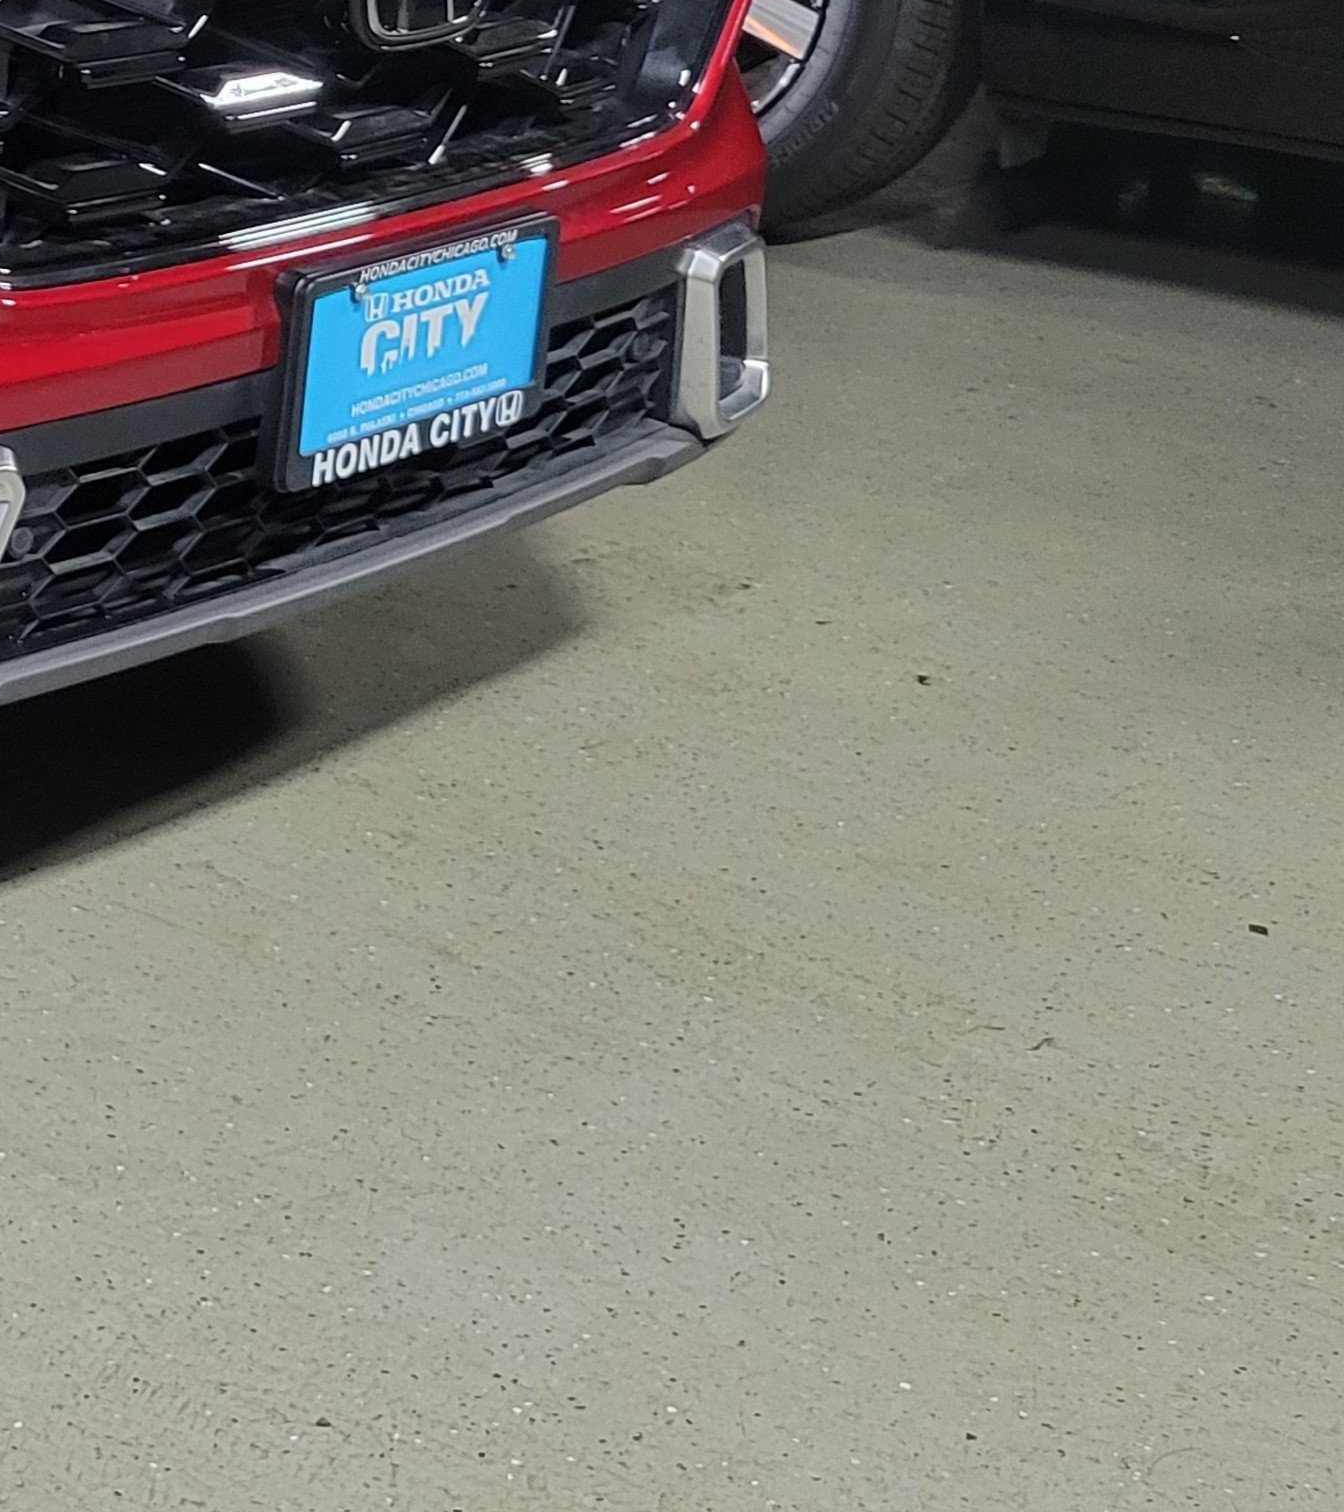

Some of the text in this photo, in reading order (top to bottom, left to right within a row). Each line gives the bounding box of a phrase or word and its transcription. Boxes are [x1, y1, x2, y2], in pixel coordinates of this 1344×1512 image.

[358, 228, 518, 283] HONDACITYCHICAGO.COM
[390, 268, 491, 313] HONDA
[359, 290, 490, 378] CITY
[350, 362, 489, 418] HONDACITYCHICAGO.COM
[311, 422, 423, 488] HONDA
[429, 396, 497, 448] CITY
